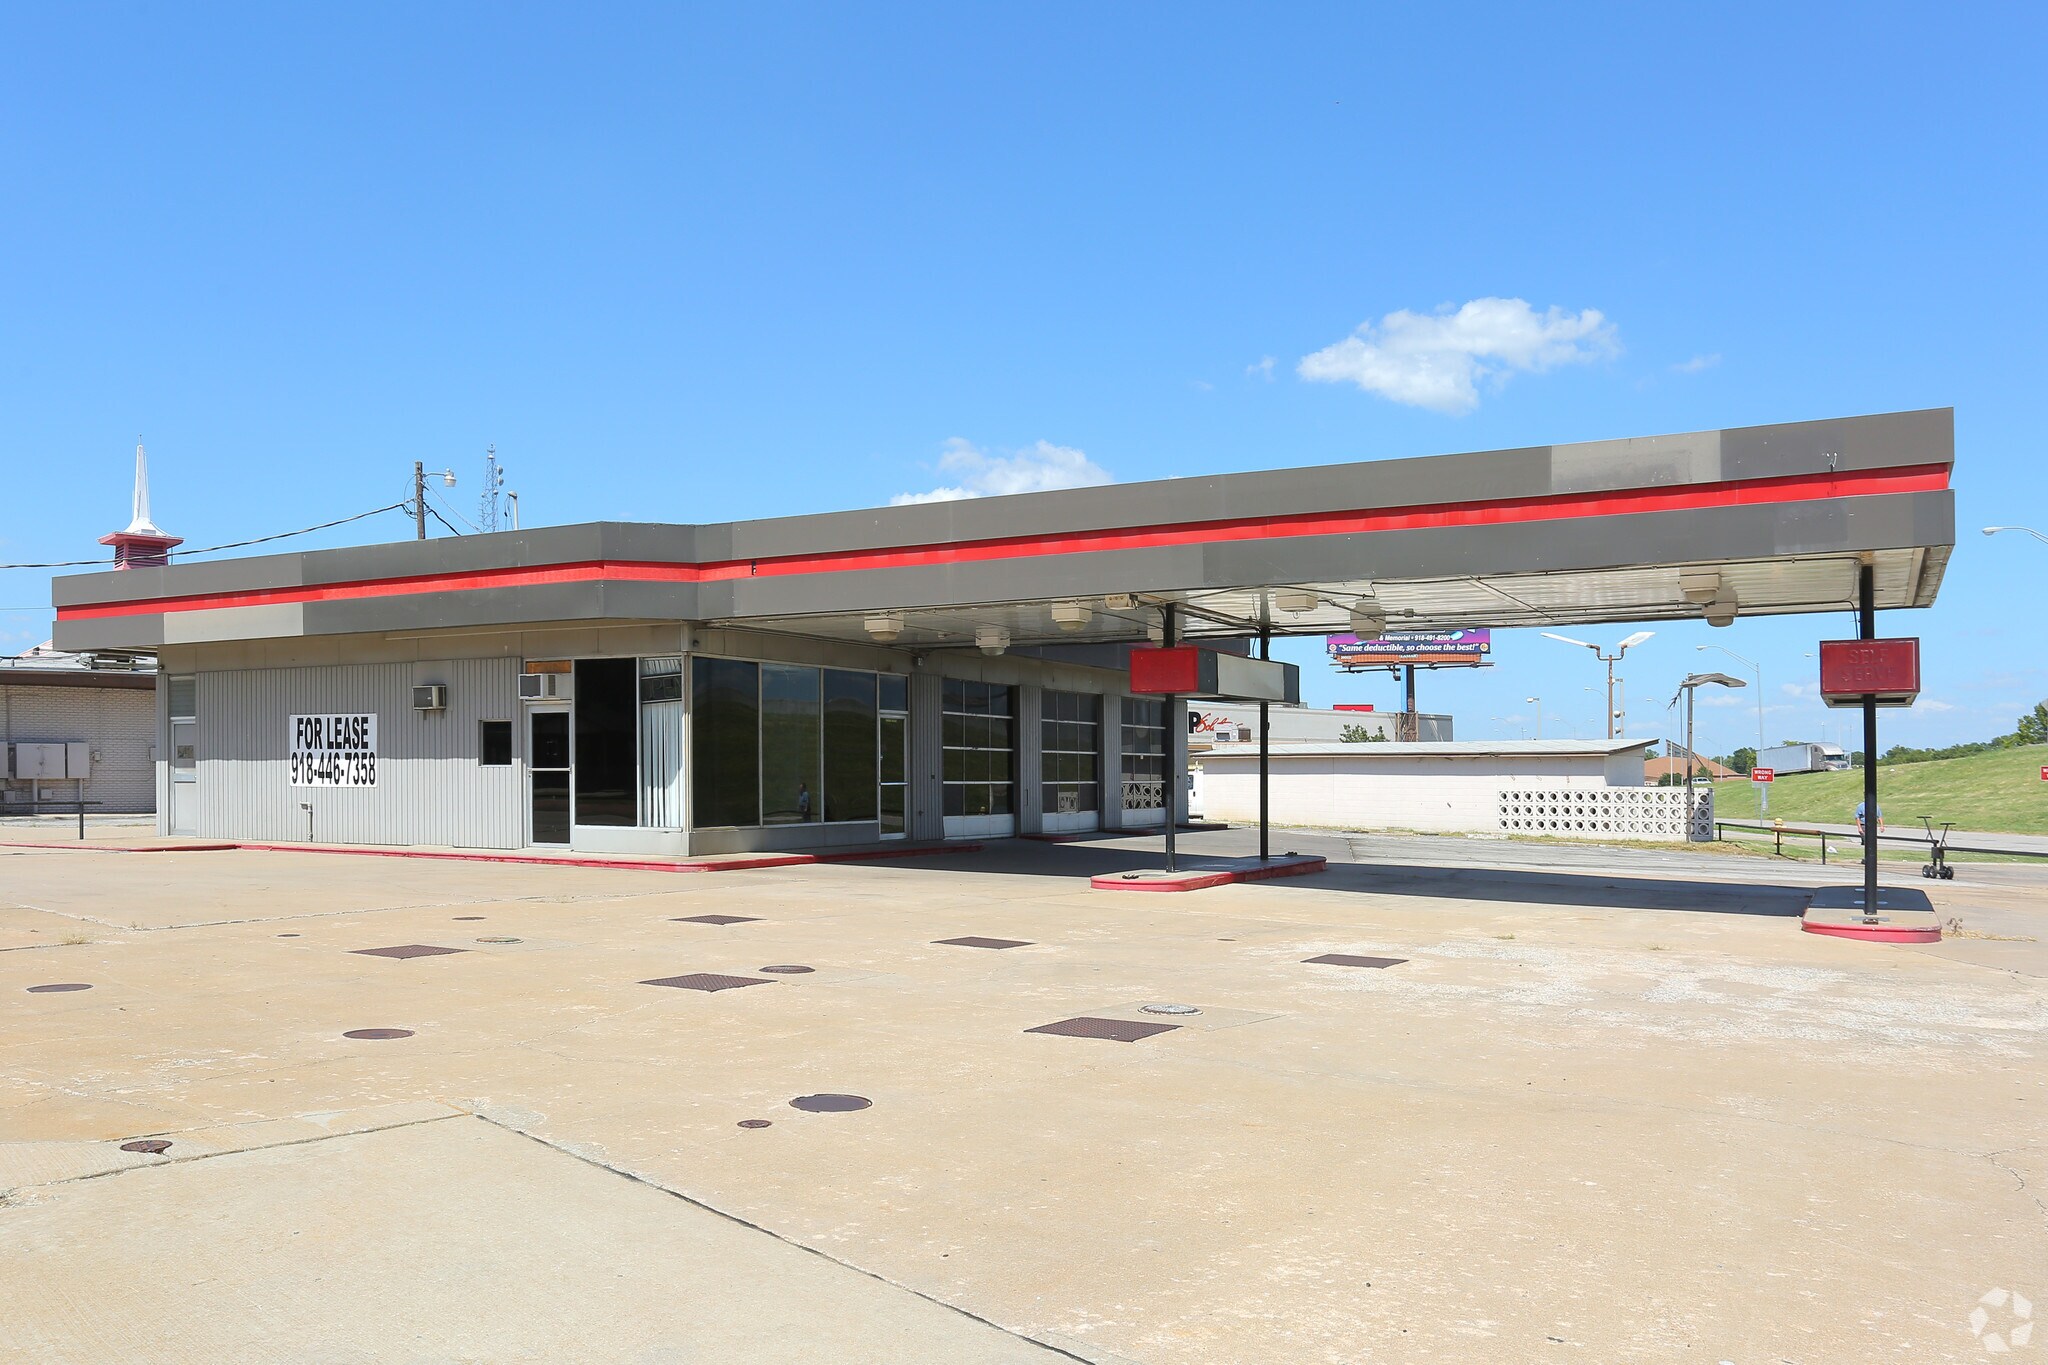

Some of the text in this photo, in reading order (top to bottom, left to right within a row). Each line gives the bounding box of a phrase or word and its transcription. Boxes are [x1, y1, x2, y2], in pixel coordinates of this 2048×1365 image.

[1364, 643, 1405, 653] deductible,
[1416, 643, 1442, 651] choose
[1443, 643, 1456, 651] the
[1847, 648, 1889, 665] SELF
[297, 716, 369, 749] FOR LEASE
[291, 751, 376, 785] 918-446-7358
